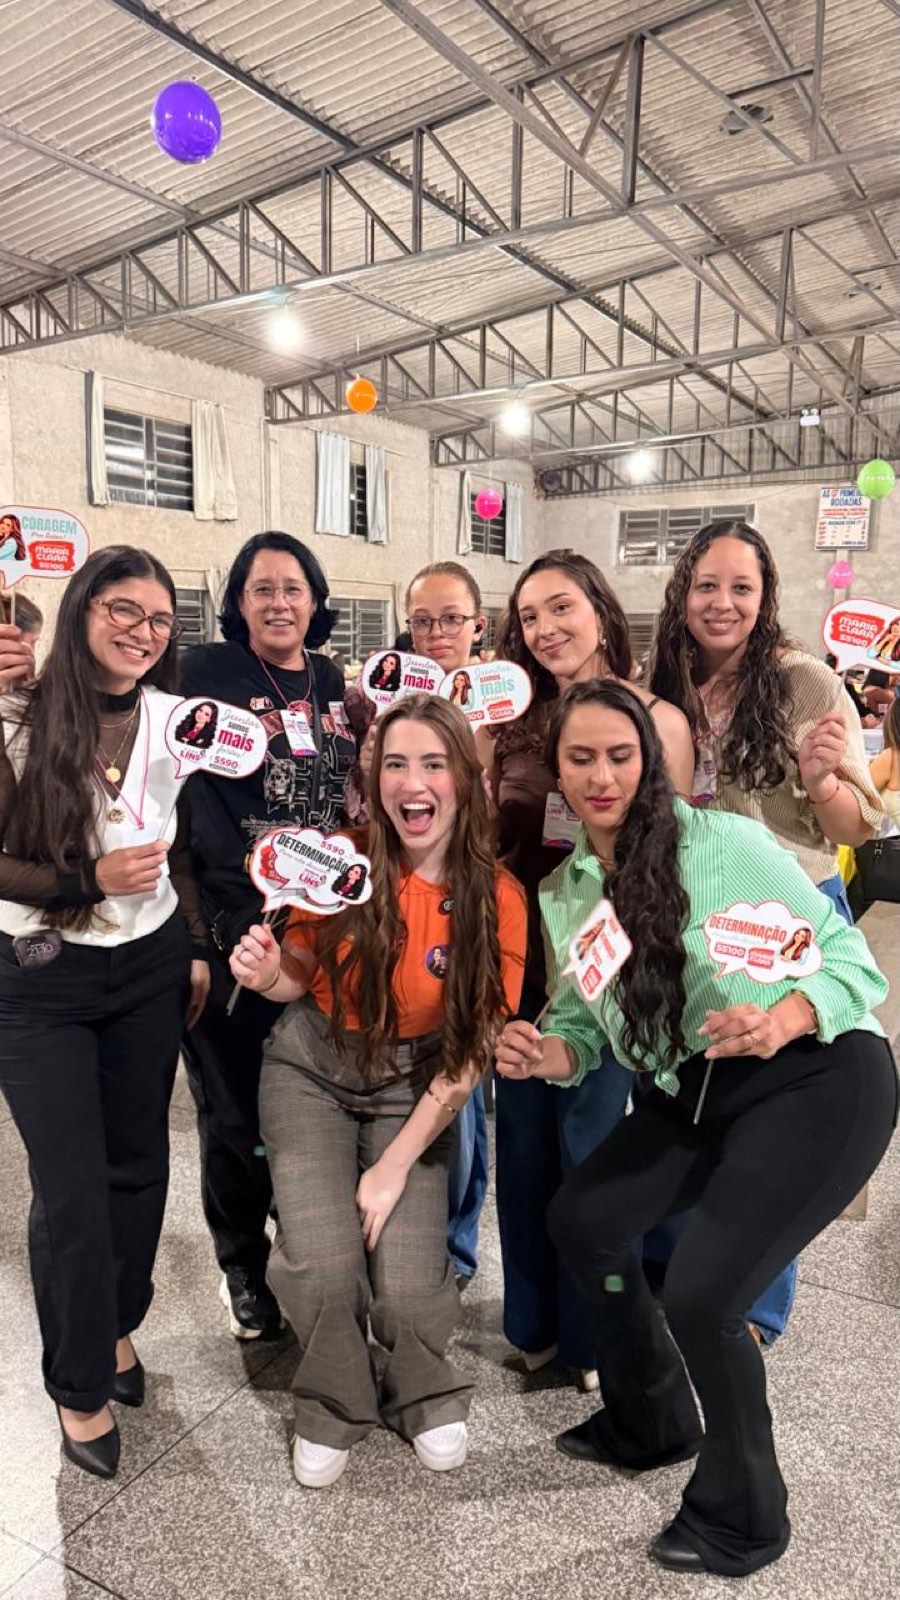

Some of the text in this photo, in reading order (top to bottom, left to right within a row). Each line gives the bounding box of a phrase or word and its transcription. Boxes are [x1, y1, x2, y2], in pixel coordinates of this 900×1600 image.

[22, 515, 77, 535] CORAGEM
[35, 545, 69, 555] MARIA
[35, 553, 68, 563] CLARA
[839, 616, 878, 632] MARIA
[839, 624, 874, 640] CLARA
[403, 674, 435, 691] mais
[480, 677, 515, 697] mais
[227, 721, 250, 733] somos
[217, 729, 255, 752] mais
[180, 750, 201, 761] LINS
[213, 755, 239, 769] 5590
[277, 834, 349, 873] DETERMINAÇÃO
[320, 840, 345, 856] 5590
[299, 873, 320, 888] LINS
[709, 915, 787, 944] DETERMINAÇÃO
